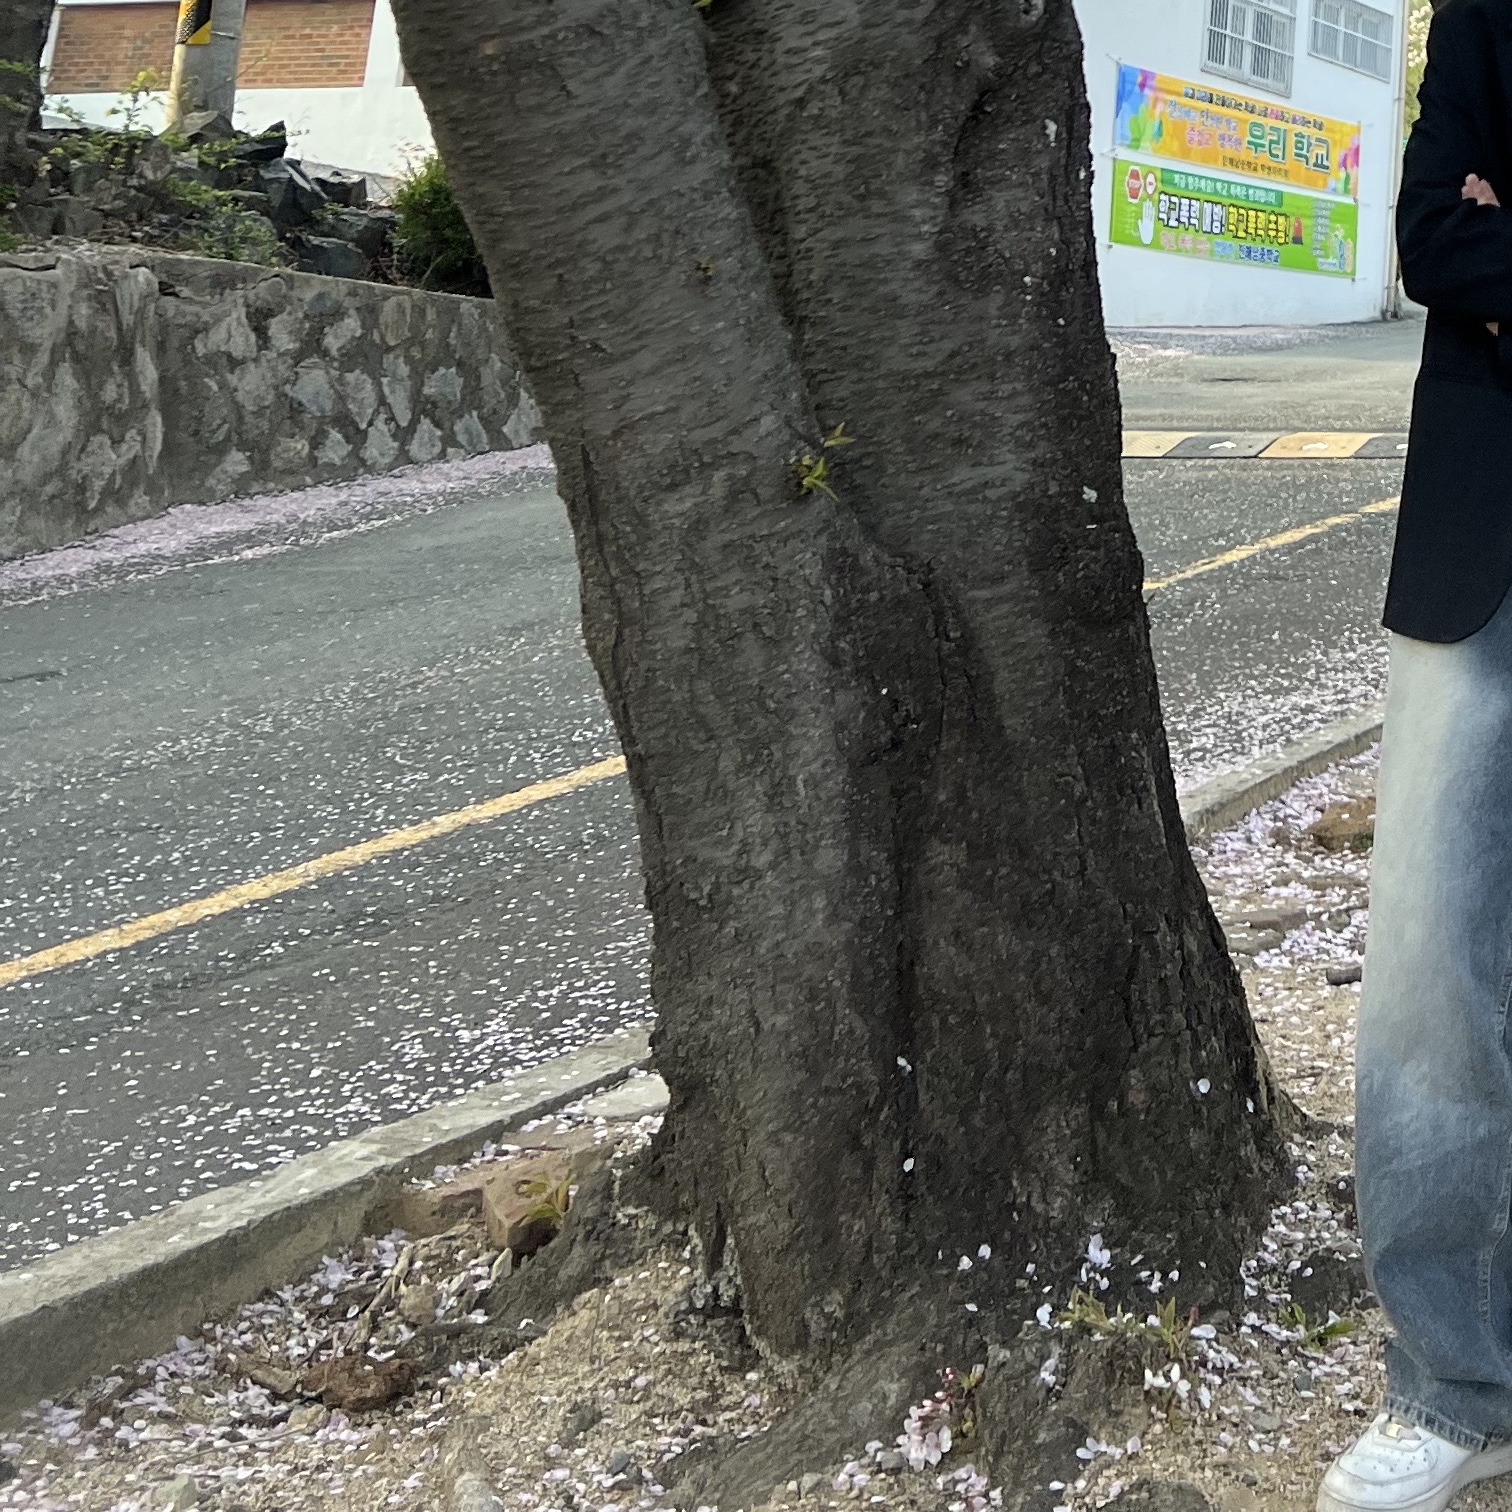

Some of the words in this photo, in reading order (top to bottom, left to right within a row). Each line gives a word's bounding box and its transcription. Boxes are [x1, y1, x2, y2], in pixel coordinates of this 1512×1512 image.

[1246, 121, 1287, 162] 우리
[1293, 131, 1330, 172] 학교
[1158, 191, 1200, 233] 학교폭력
[1228, 203, 1267, 244] 학교폭력
